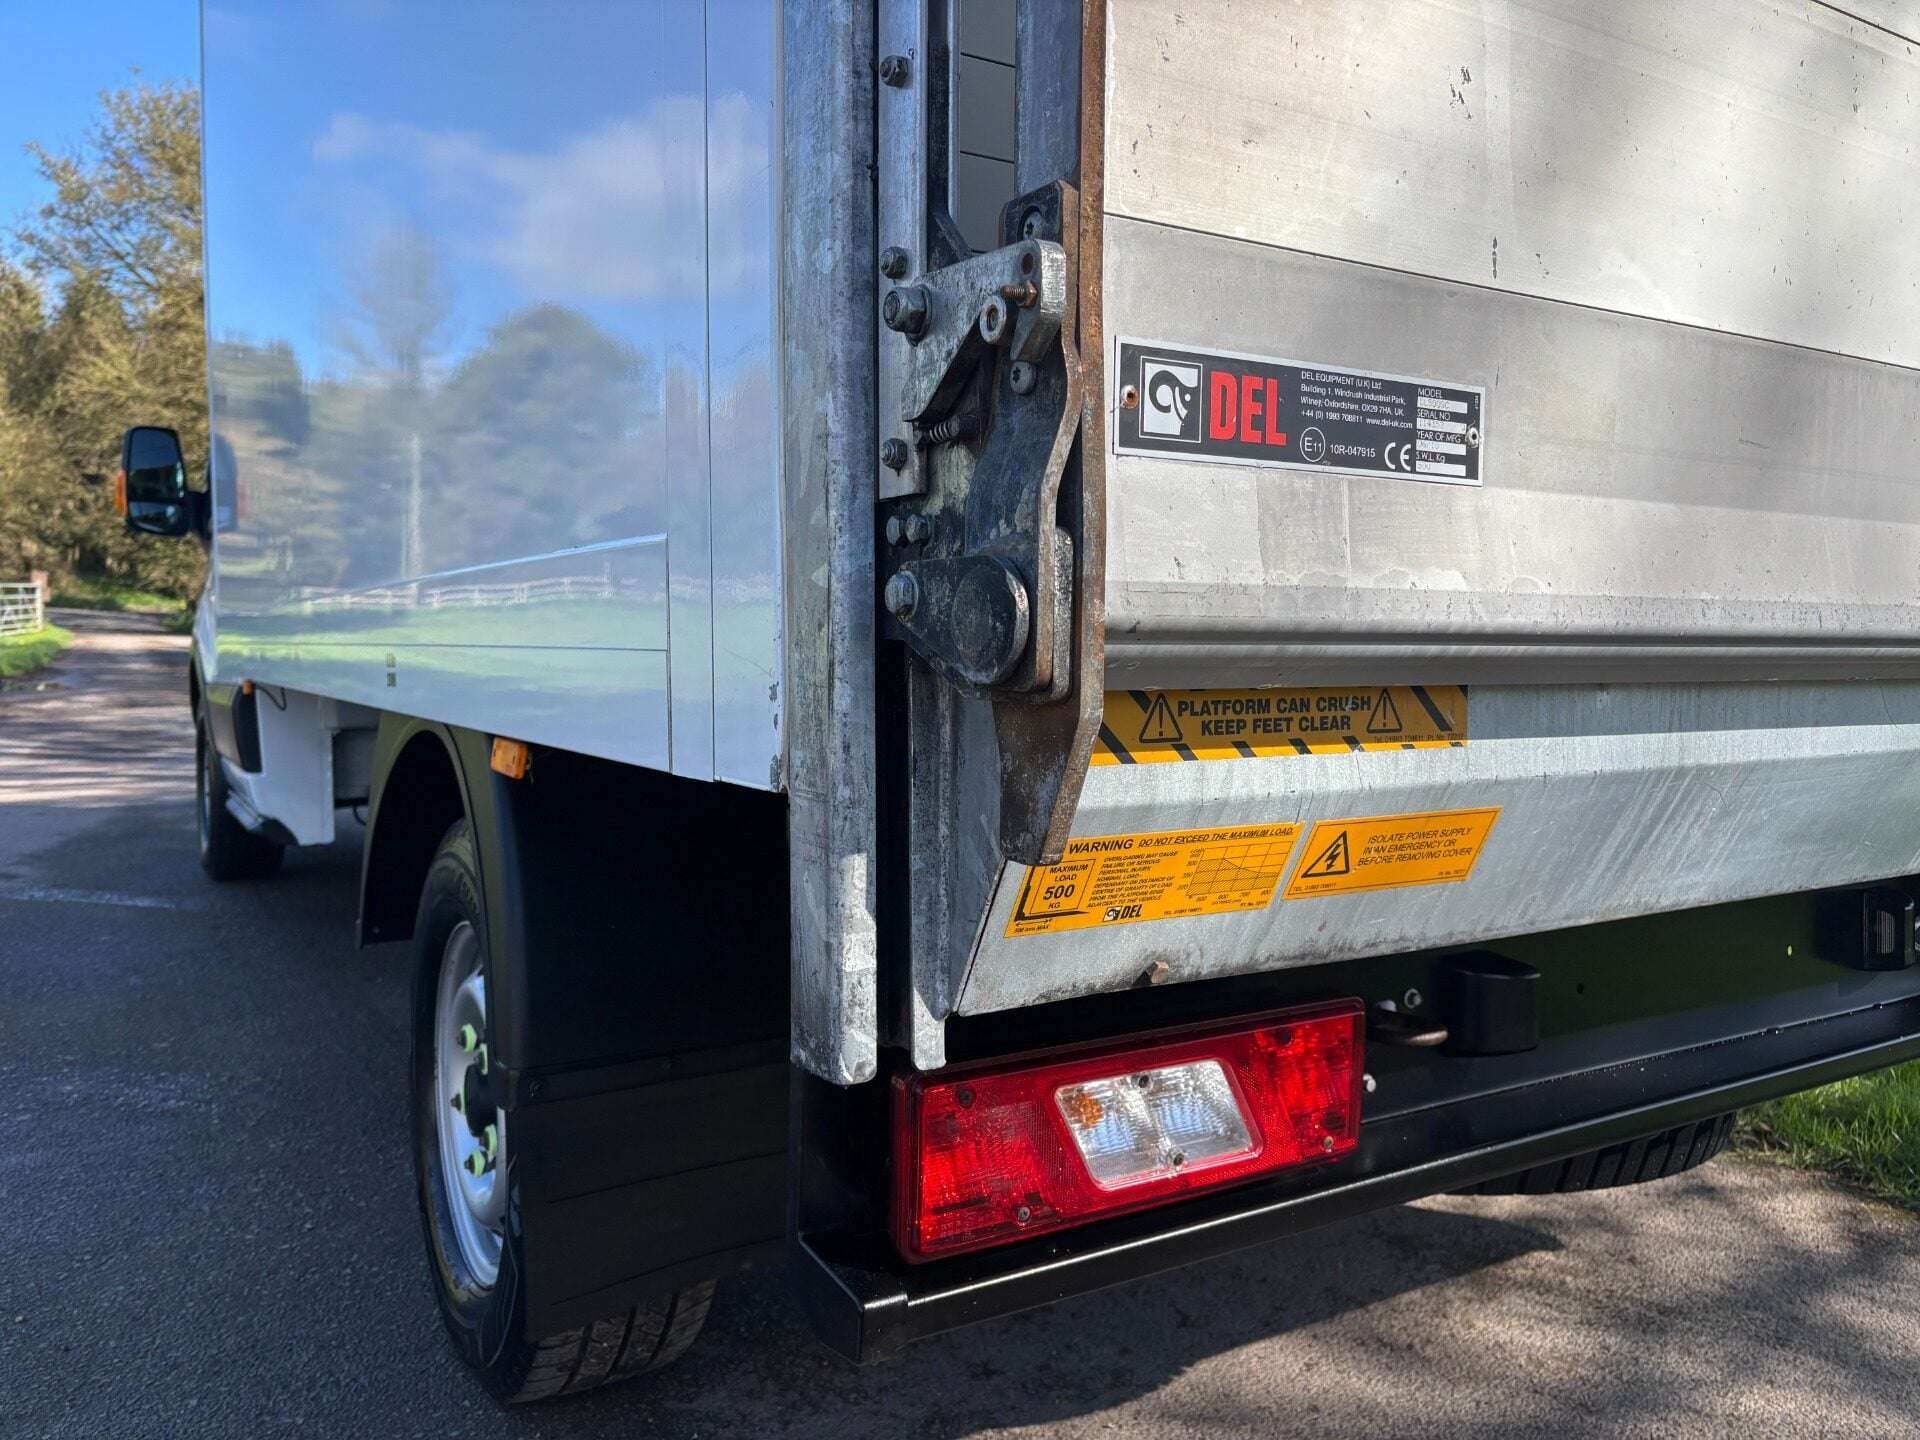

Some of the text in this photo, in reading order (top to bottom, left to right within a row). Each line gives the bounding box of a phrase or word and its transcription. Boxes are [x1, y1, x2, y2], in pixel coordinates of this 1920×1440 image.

[1301, 370, 1314, 380] DEL
[1315, 373, 1354, 386] EQUIPMENT
[1301, 383, 1326, 396] Building
[1334, 388, 1363, 399] Windrush
[1364, 393, 1390, 403] Industrial
[1417, 387, 1442, 398] MODEL
[1208, 370, 1288, 447] DEL
[1301, 409, 1314, 417] +44
[1315, 410, 1324, 420] (0)
[1326, 411, 1340, 421] 1993
[1361, 404, 1378, 413] OX29
[1416, 409, 1451, 421] SERIAL NO
[1366, 417, 1413, 429] www.del-uk.com
[1416, 430, 1461, 443] YEAR OF MFG
[1330, 443, 1376, 458] 10R-047915
[1436, 453, 1446, 464] Kg
[1177, 695, 1371, 717] PLATFORM CAN CRUSH
[1200, 715, 1351, 737] KEEP FEET CLEAR
[1069, 838, 1134, 854] WARNING
[1138, 838, 1153, 847] DO
[1153, 837, 1173, 846] NOT
[1174, 834, 1210, 845] EXCEED
[1211, 832, 1229, 842] THE
[1229, 829, 1270, 841] MAXIMUM
[1368, 827, 1473, 844] ISOLATE POWER SUPPLY
[1363, 839, 1457, 855] IN AN EMERGENCY OR
[1357, 848, 1472, 866] BEFORE REMOVING COVER
[1050, 864, 1089, 874] MAXIMUM
[1055, 874, 1077, 882] LOAD
[1043, 884, 1075, 900] 500
[1048, 901, 1061, 909] KG
[1120, 904, 1142, 919] DEL
